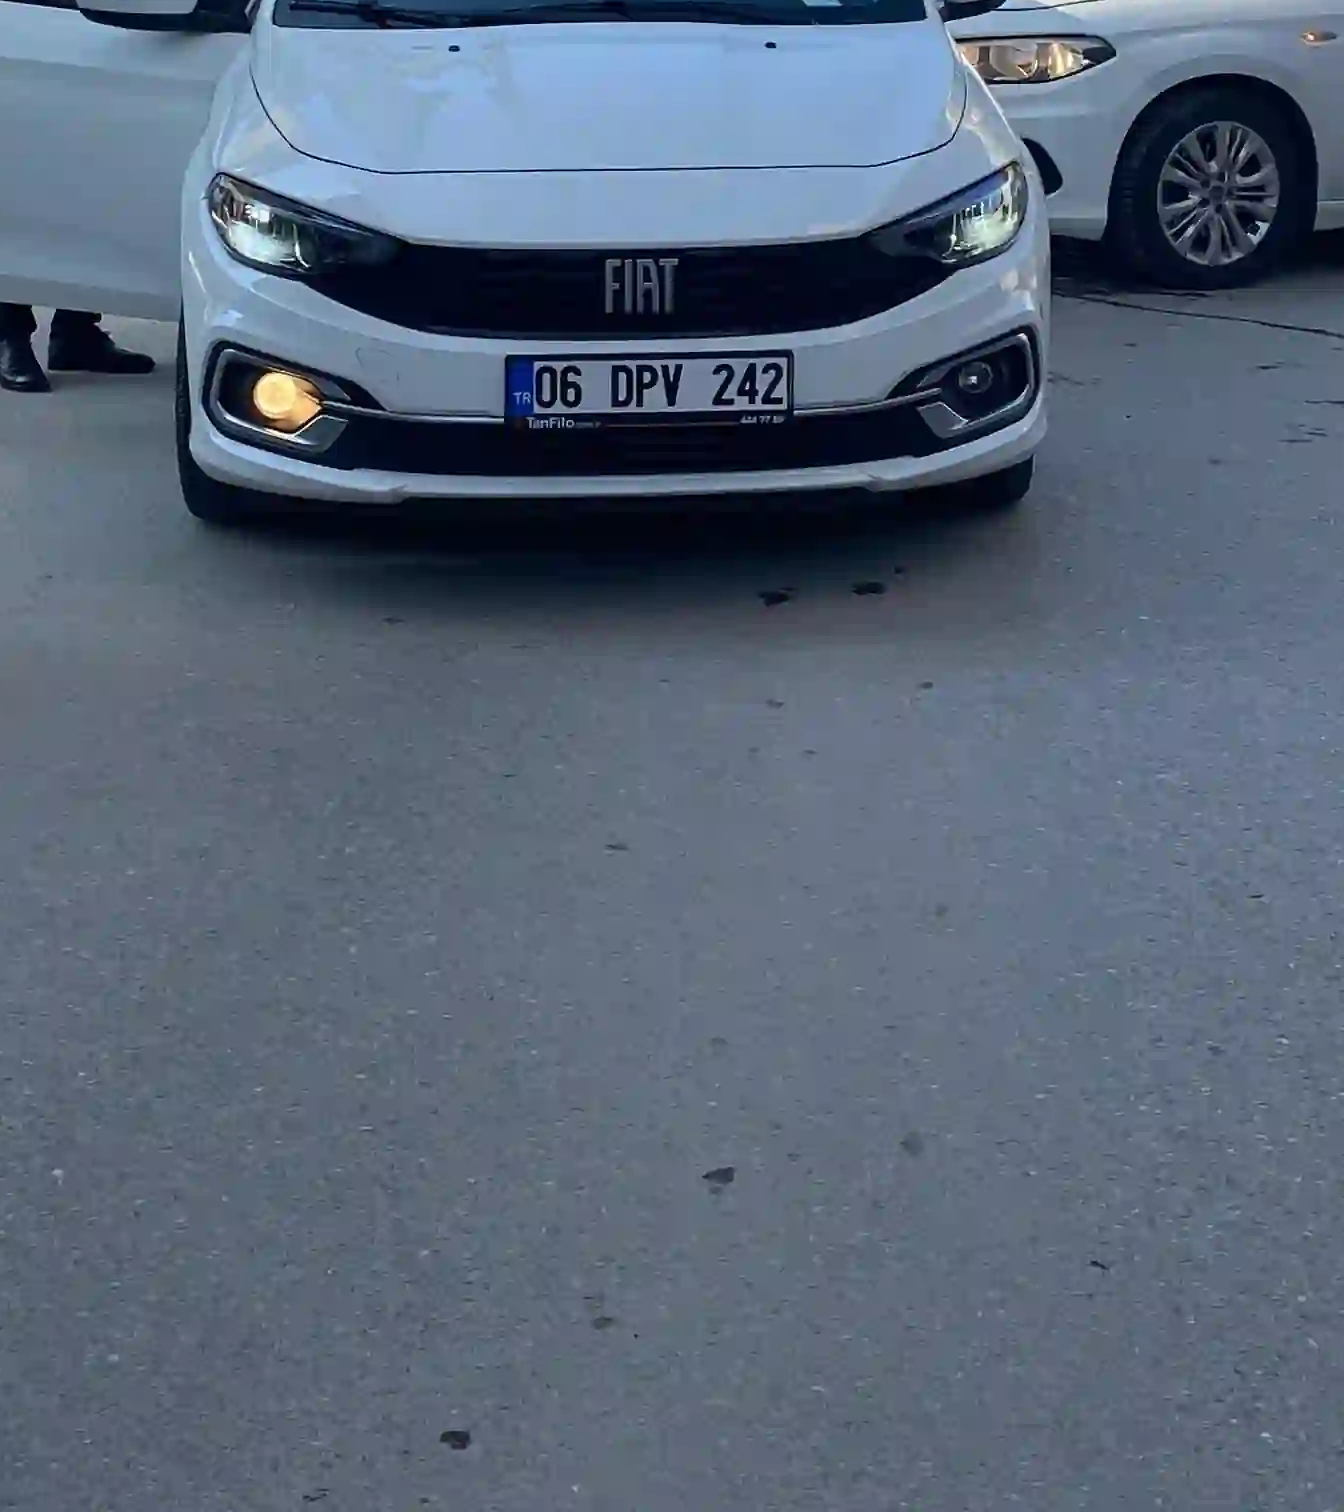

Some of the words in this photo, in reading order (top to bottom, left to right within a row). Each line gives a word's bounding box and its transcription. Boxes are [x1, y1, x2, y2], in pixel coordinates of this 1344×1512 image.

[604, 257, 680, 315] FIAT
[513, 391, 533, 406] TR
[535, 364, 583, 410] 06
[610, 362, 684, 409] DPV
[711, 361, 785, 407] 242
